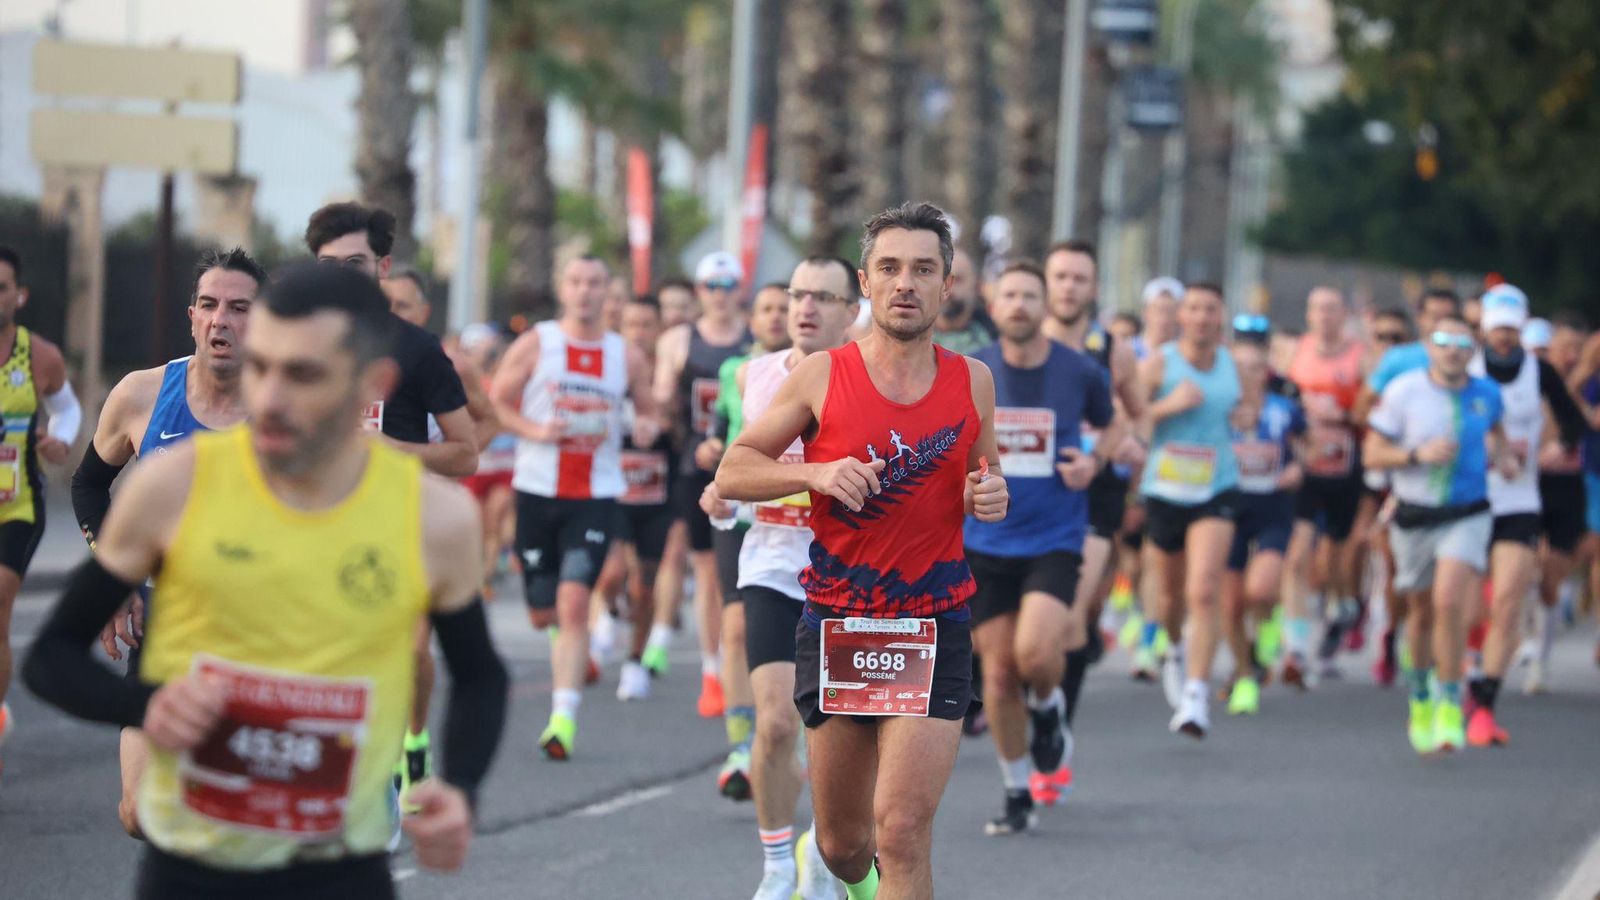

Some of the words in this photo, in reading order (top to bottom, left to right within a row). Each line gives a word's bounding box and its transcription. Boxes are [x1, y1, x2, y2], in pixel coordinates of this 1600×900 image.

[892, 467, 908, 482] de
[908, 431, 957, 471] Semisens
[853, 651, 906, 671] 6698
[861, 671, 896, 680] POSSÉMÉ
